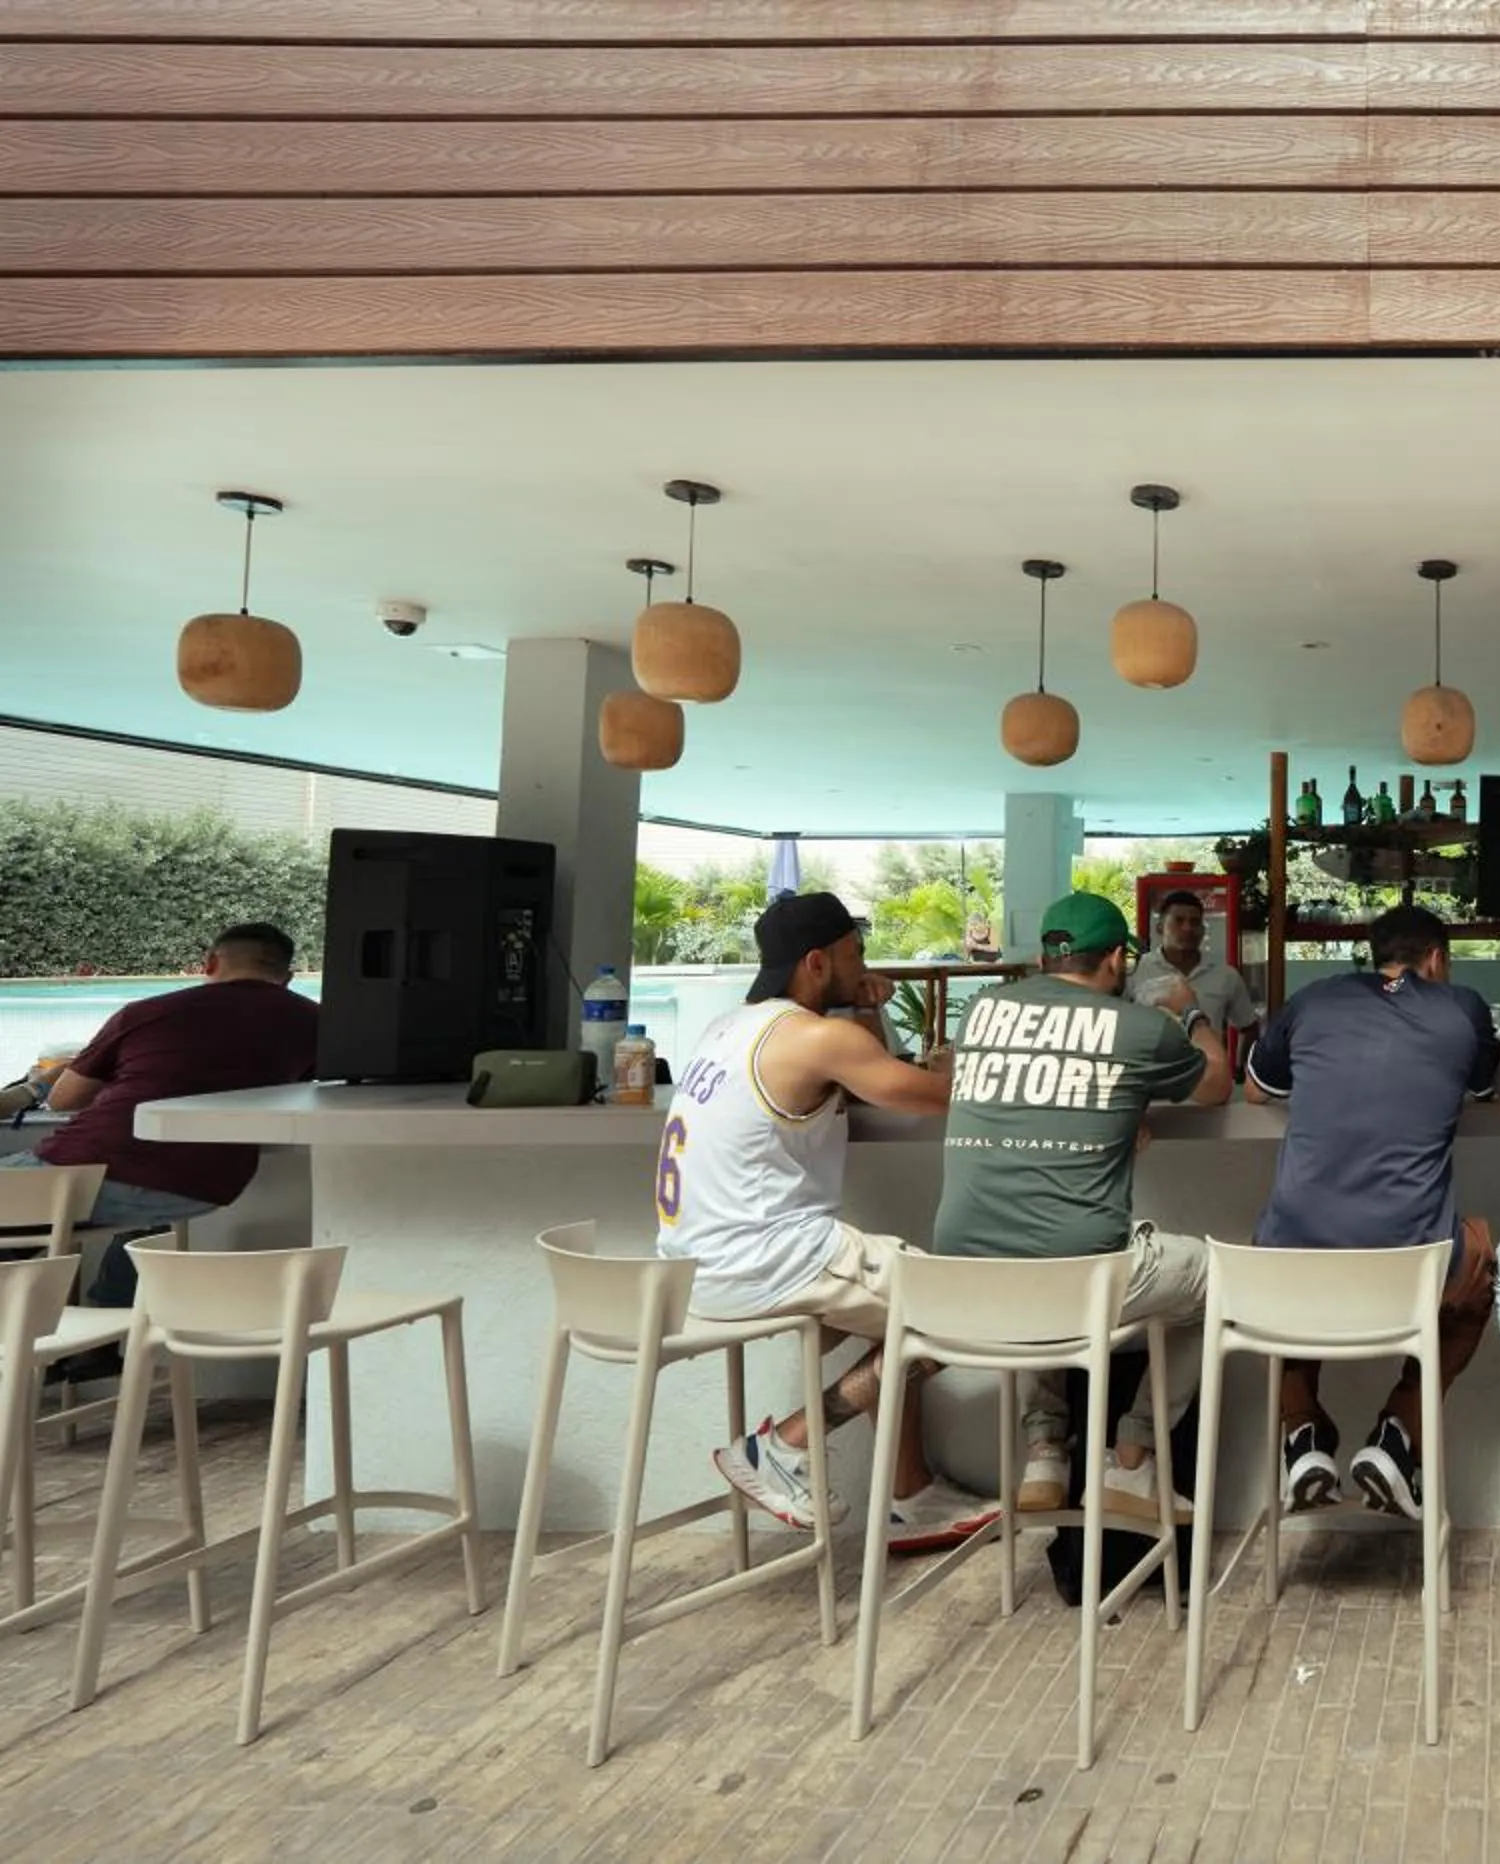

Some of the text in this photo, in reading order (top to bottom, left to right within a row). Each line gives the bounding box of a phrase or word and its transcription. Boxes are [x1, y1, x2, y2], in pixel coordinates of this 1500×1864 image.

[963, 997, 1119, 1055] DREAM
[951, 1051, 1125, 1109] FACTORY
[657, 1116, 688, 1225] 6
